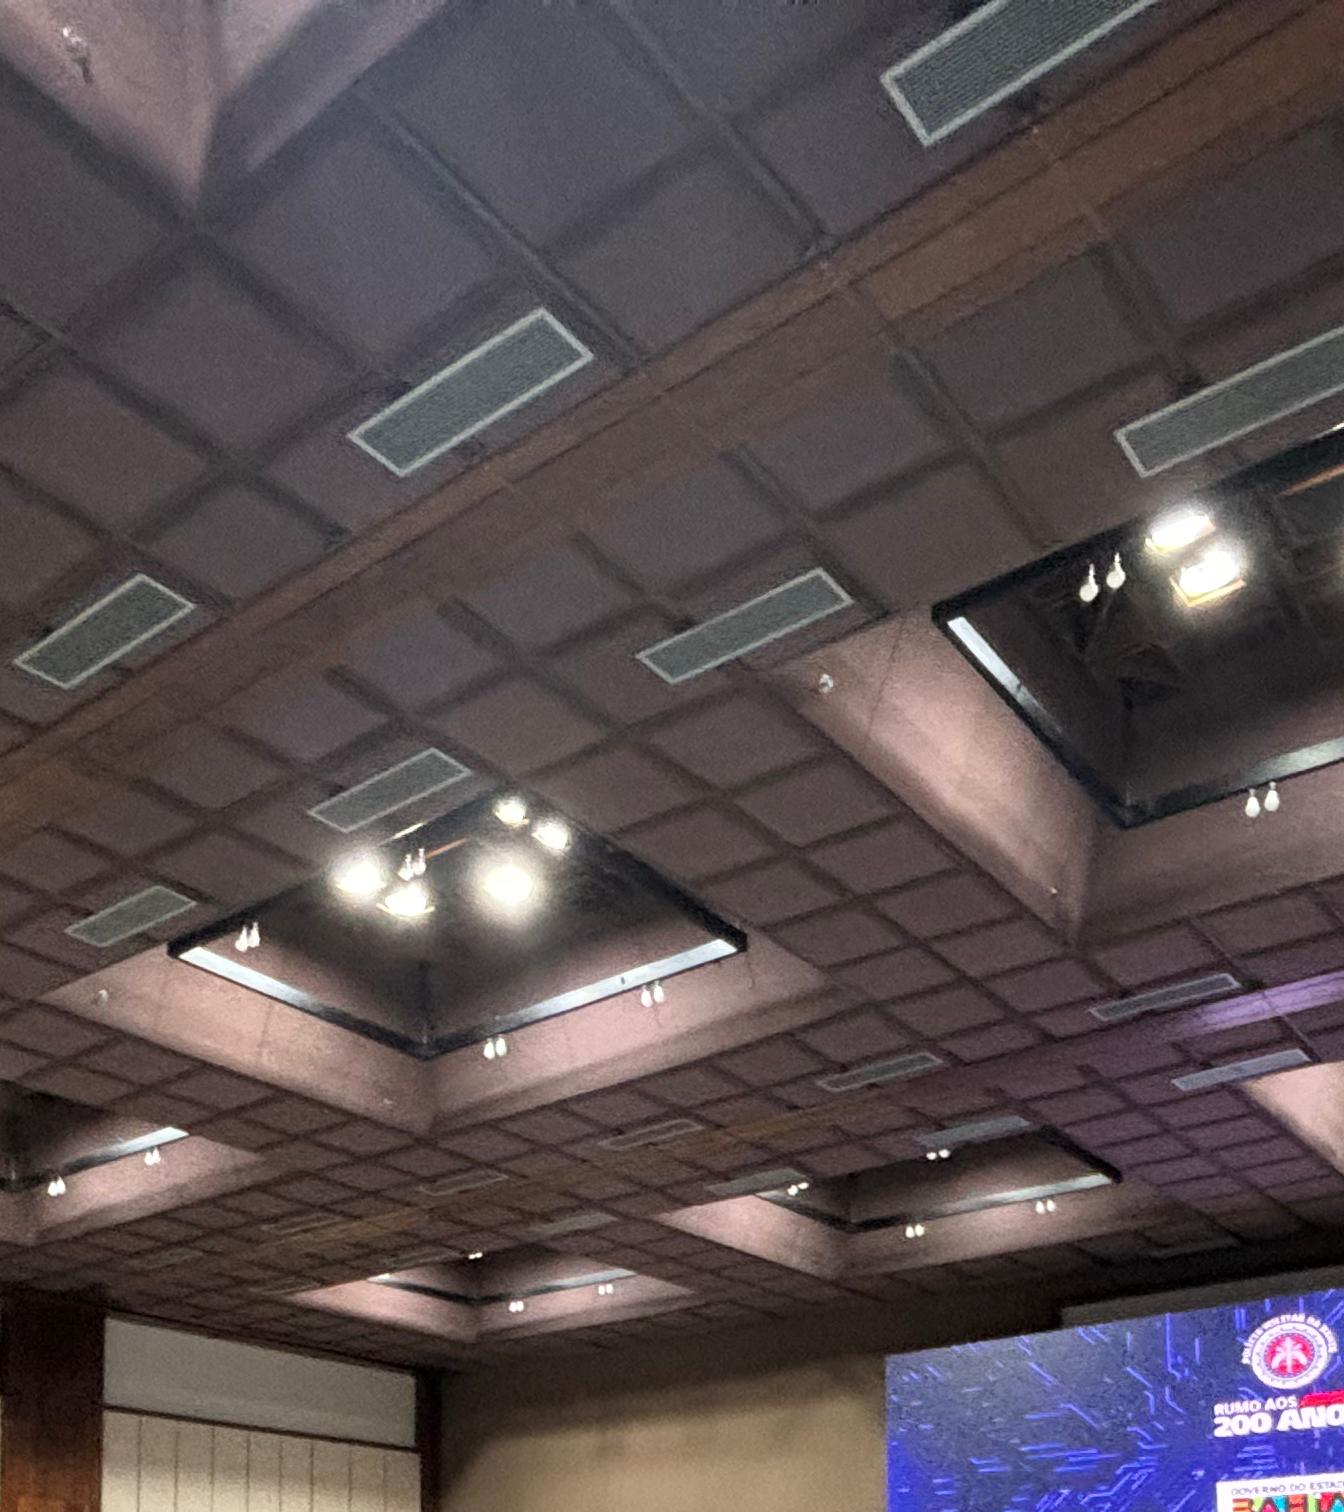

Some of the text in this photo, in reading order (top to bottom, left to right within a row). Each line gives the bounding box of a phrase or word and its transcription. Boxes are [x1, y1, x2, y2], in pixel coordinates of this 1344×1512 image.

[1213, 1395, 1298, 1416] RUMO AOS
[1213, 1412, 1272, 1438] 200
